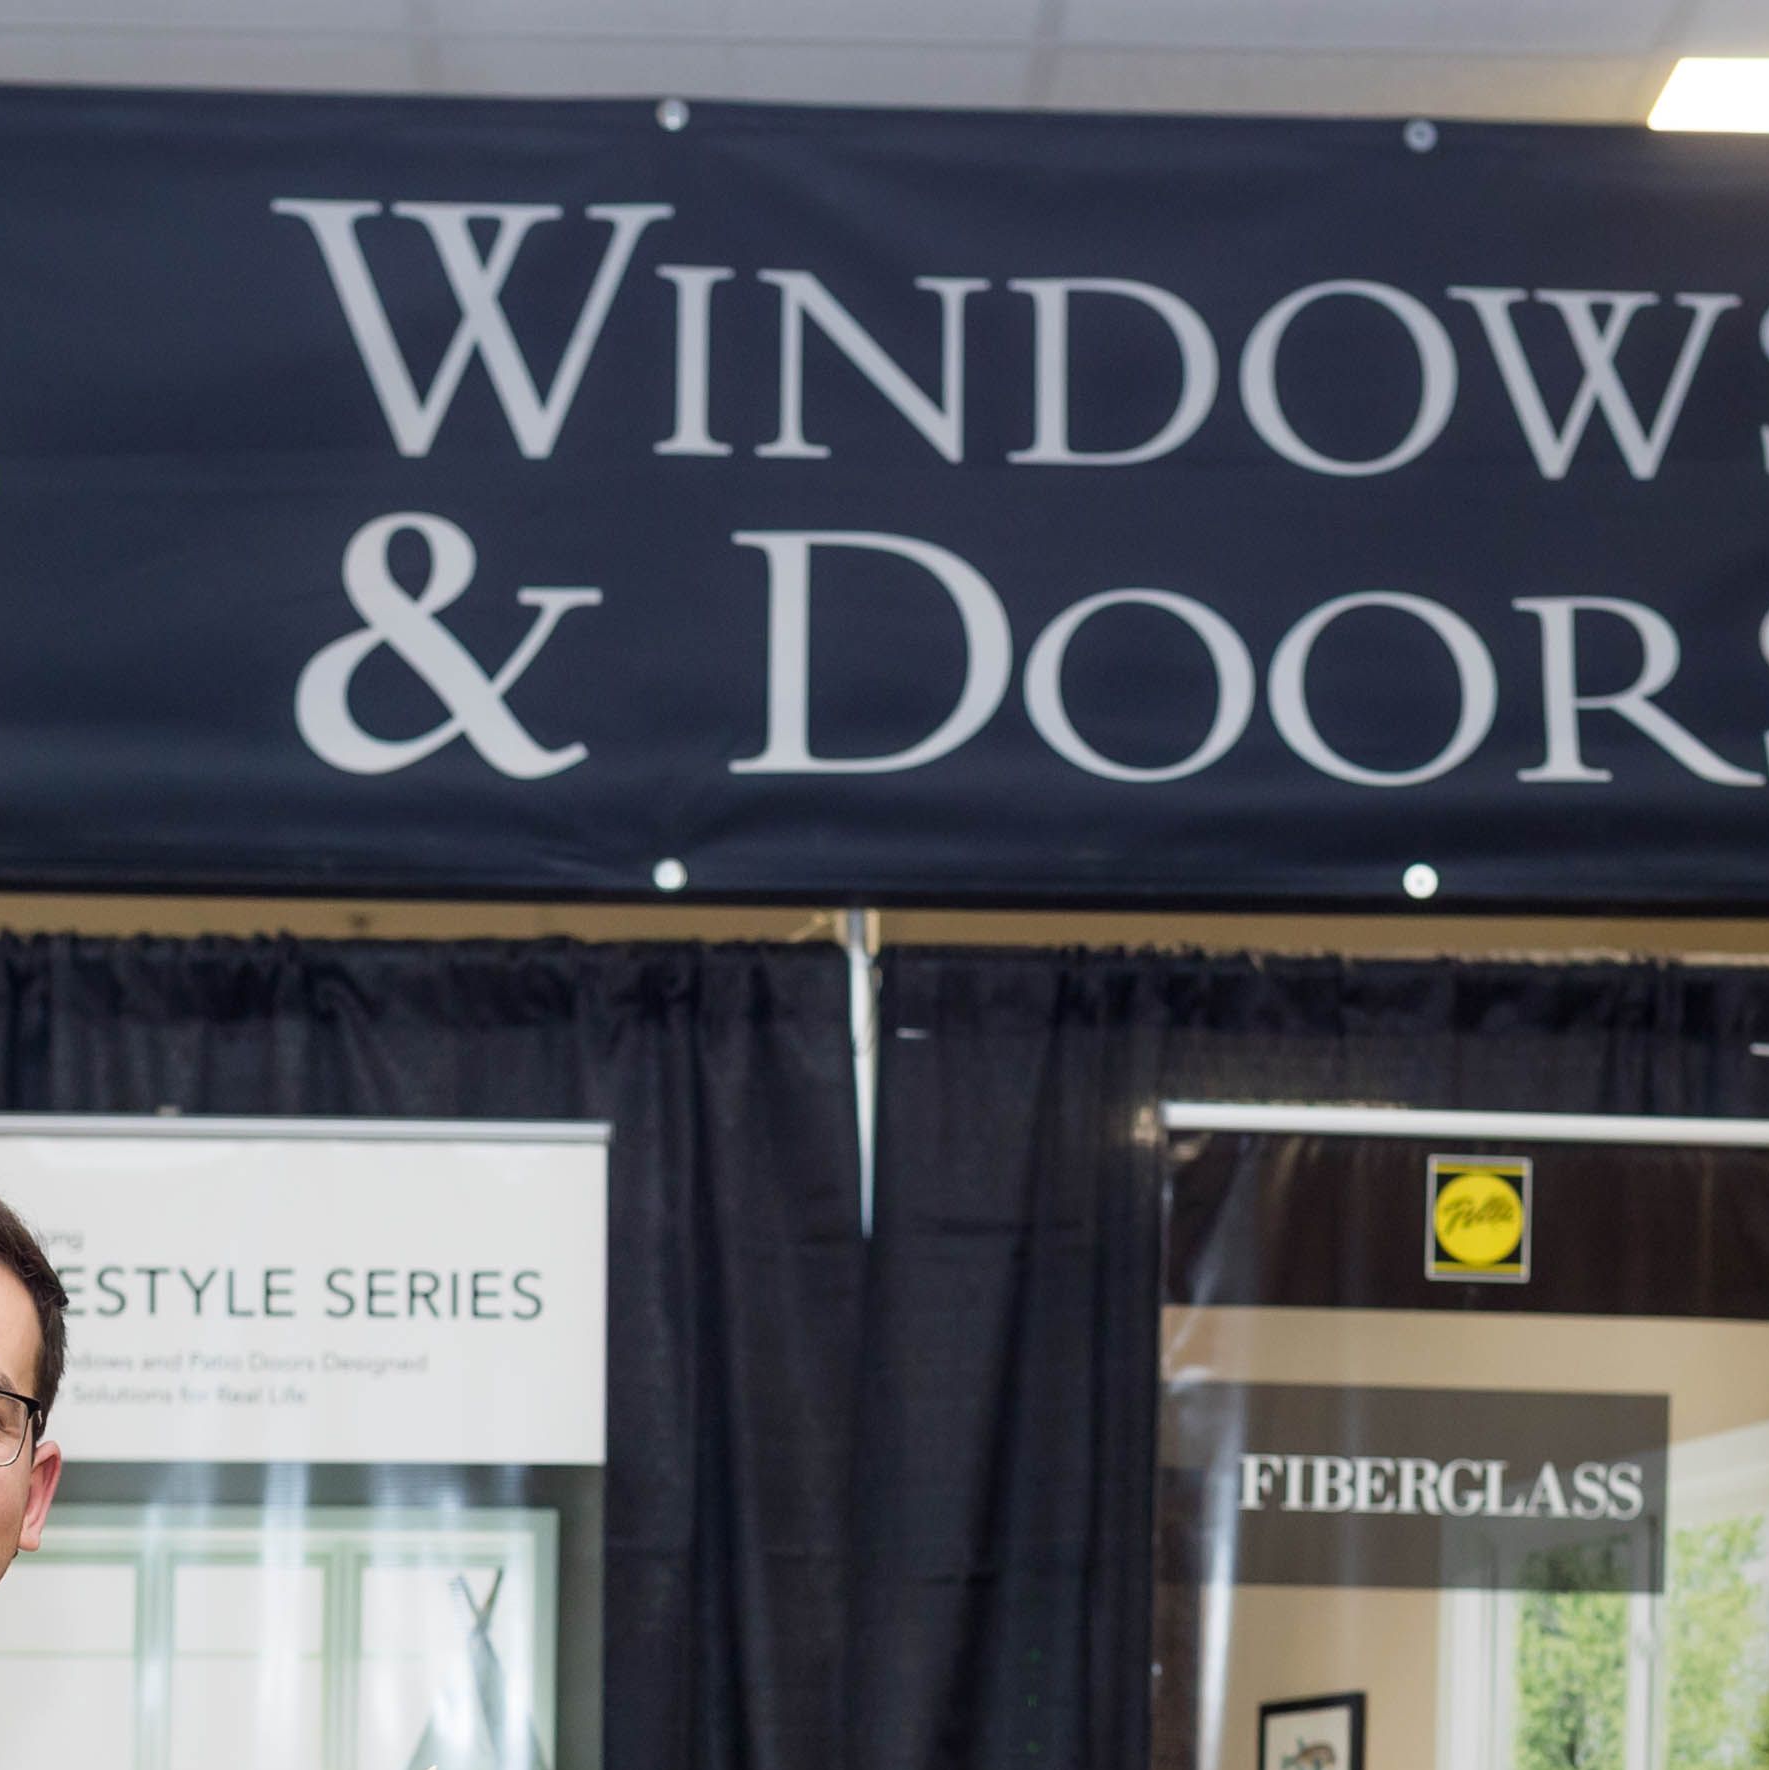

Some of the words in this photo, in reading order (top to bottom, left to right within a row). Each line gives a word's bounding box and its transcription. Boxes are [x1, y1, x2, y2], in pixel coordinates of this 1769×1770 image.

[293, 511, 604, 780] &
[56, 1266, 297, 1319] ESTYLE
[325, 1268, 545, 1322] SERIES
[141, 1350, 183, 1373] and
[248, 1351, 315, 1375] Doors
[322, 1351, 429, 1380] Designed
[72, 1383, 173, 1404] Solutions
[1238, 1452, 1645, 1521] FIBERGLASS
